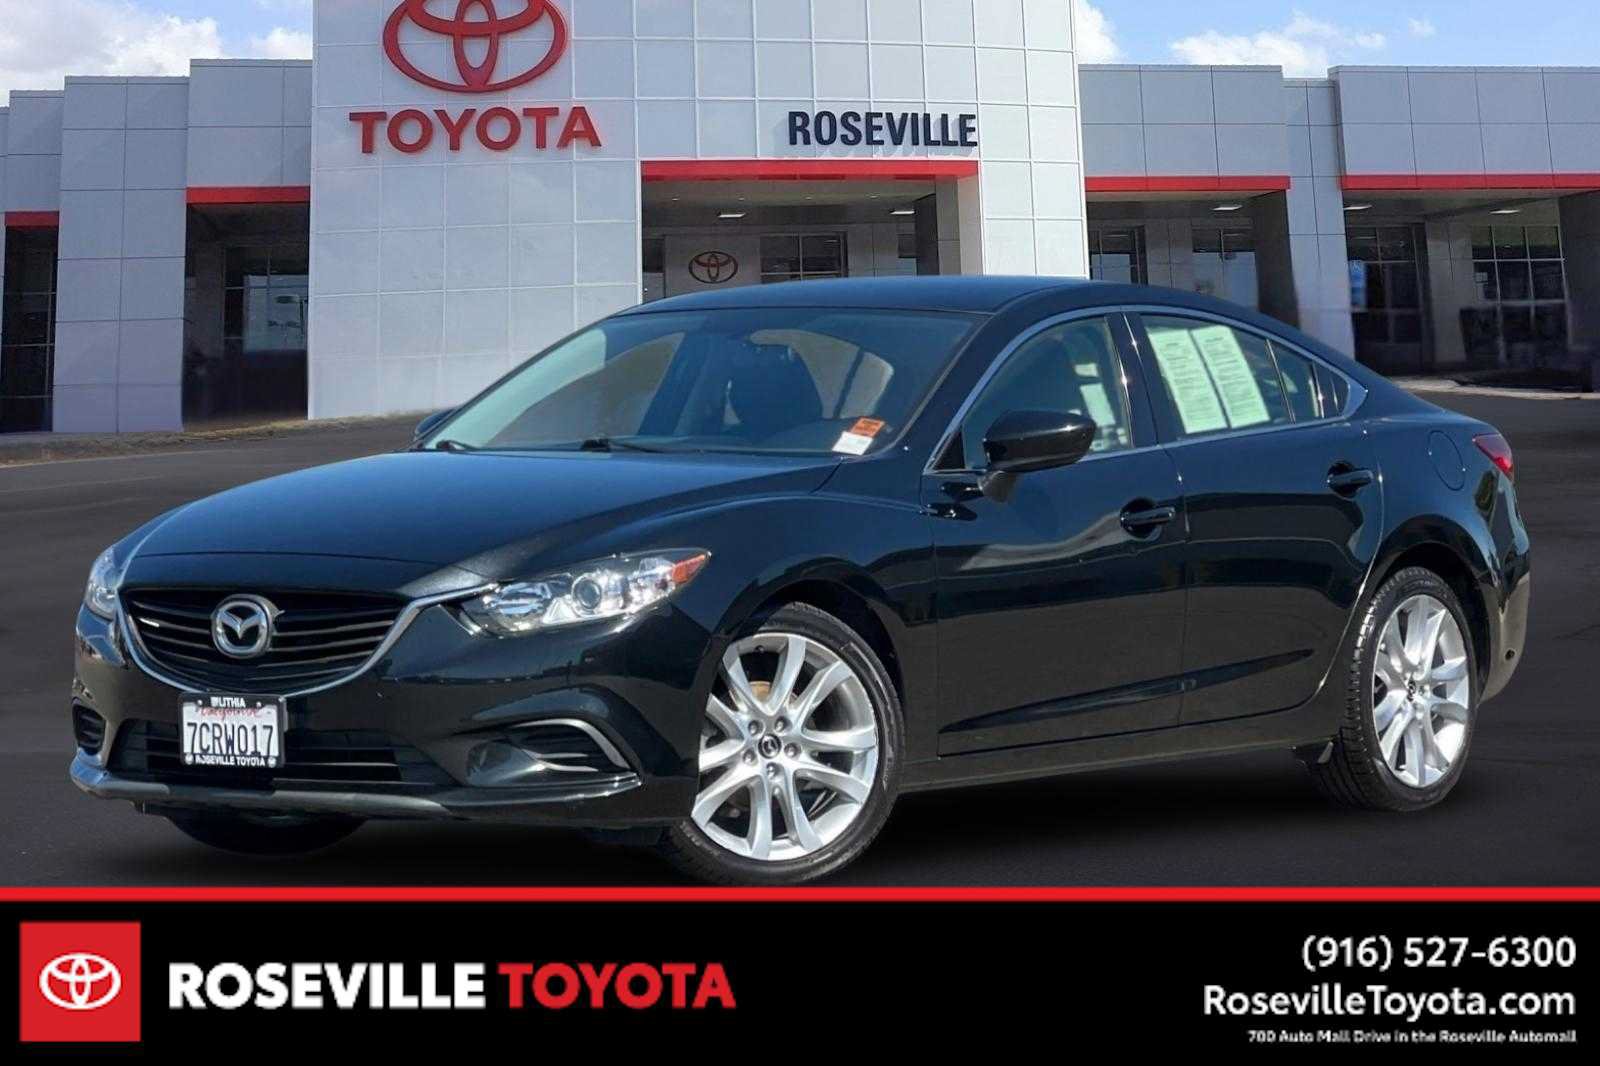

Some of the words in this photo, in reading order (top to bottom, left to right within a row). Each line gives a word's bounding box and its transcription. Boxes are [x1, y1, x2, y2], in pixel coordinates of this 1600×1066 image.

[349, 105, 602, 153] TOYOTA
[788, 111, 978, 147] ROSEVILLE
[187, 722, 274, 756] 7CRW017
[236, 756, 266, 767] TOYOTA
